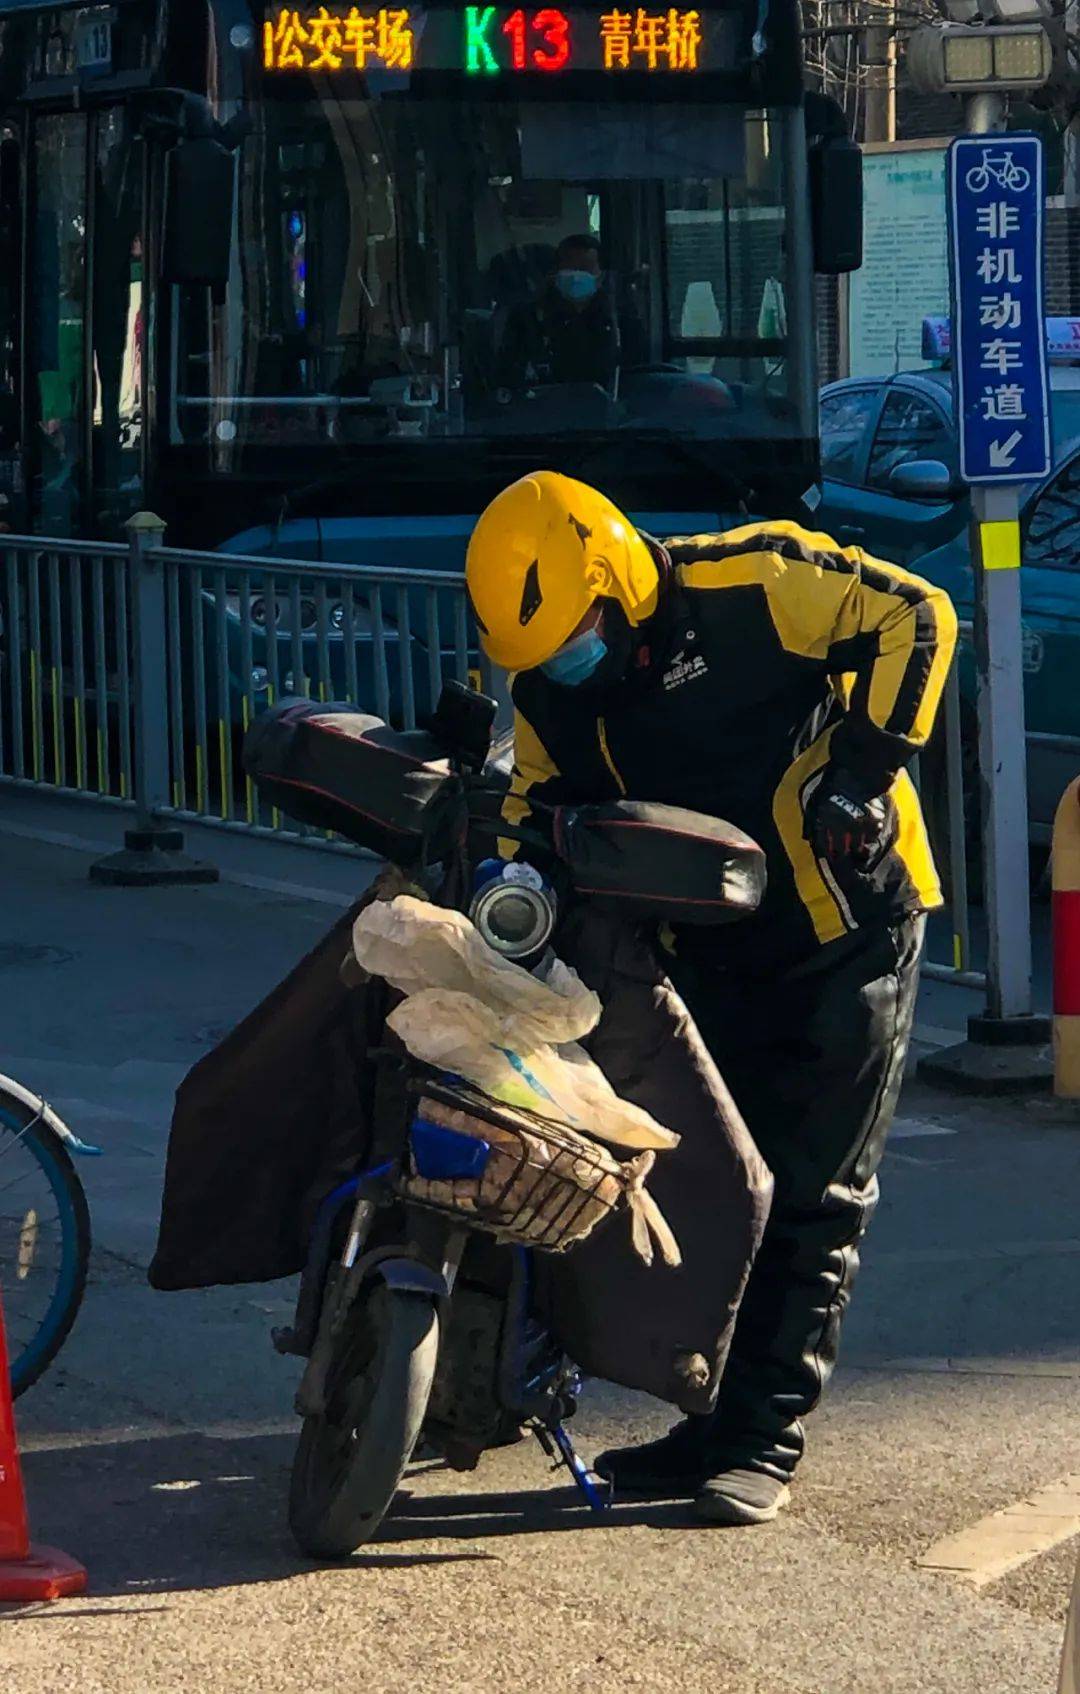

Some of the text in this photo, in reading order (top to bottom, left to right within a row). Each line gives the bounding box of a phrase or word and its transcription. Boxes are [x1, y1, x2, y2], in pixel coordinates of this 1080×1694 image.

[264, 6, 701, 71] 公交车场 K13 青年桥
[976, 201, 1027, 420] 非机动车道
